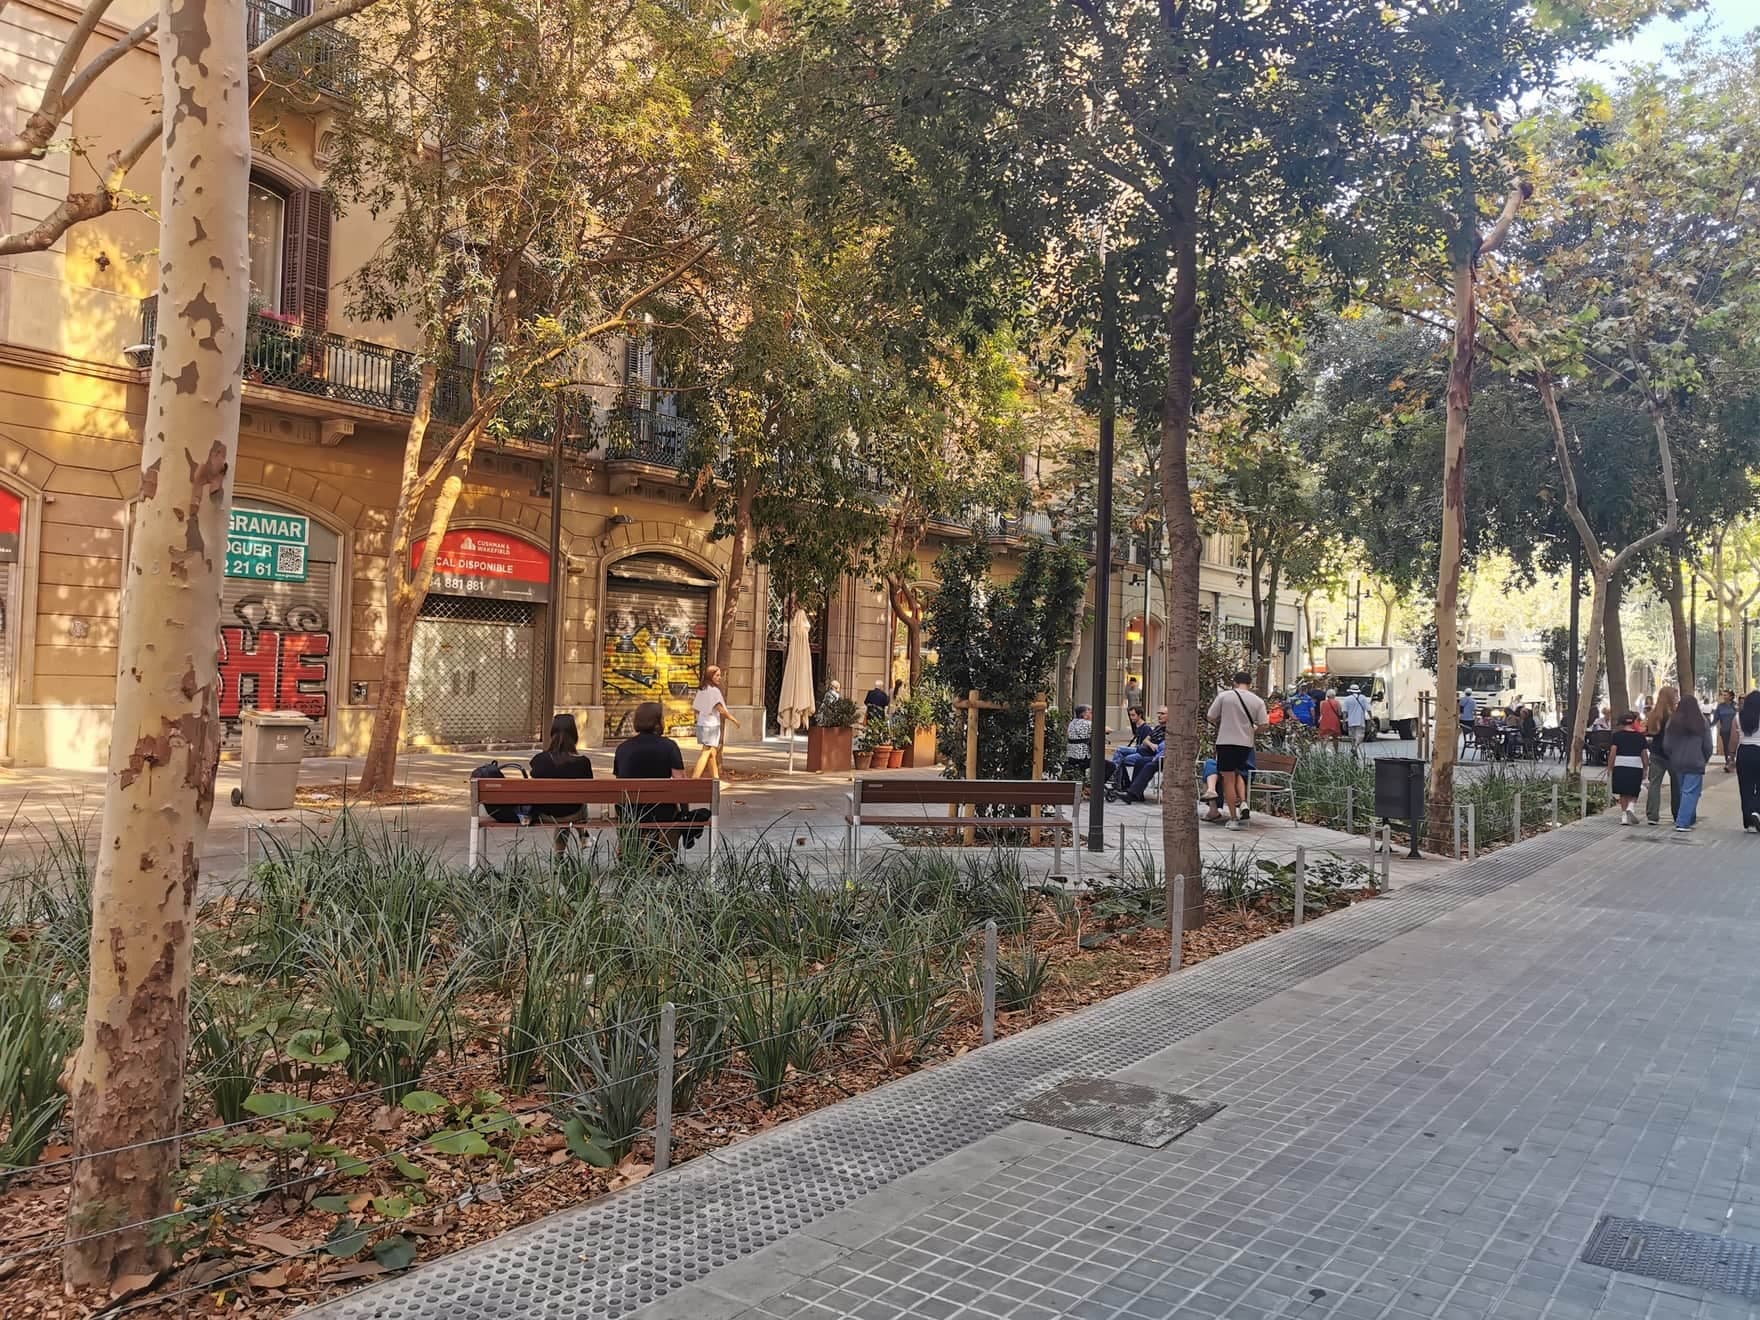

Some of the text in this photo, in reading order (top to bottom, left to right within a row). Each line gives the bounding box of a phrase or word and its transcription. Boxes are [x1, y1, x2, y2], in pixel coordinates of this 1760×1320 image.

[233, 560, 250, 575] 21
[255, 561, 272, 577] 61
[458, 559, 513, 574] DISPONIBLE
[444, 577, 464, 590] 881
[466, 580, 485, 592] 881
